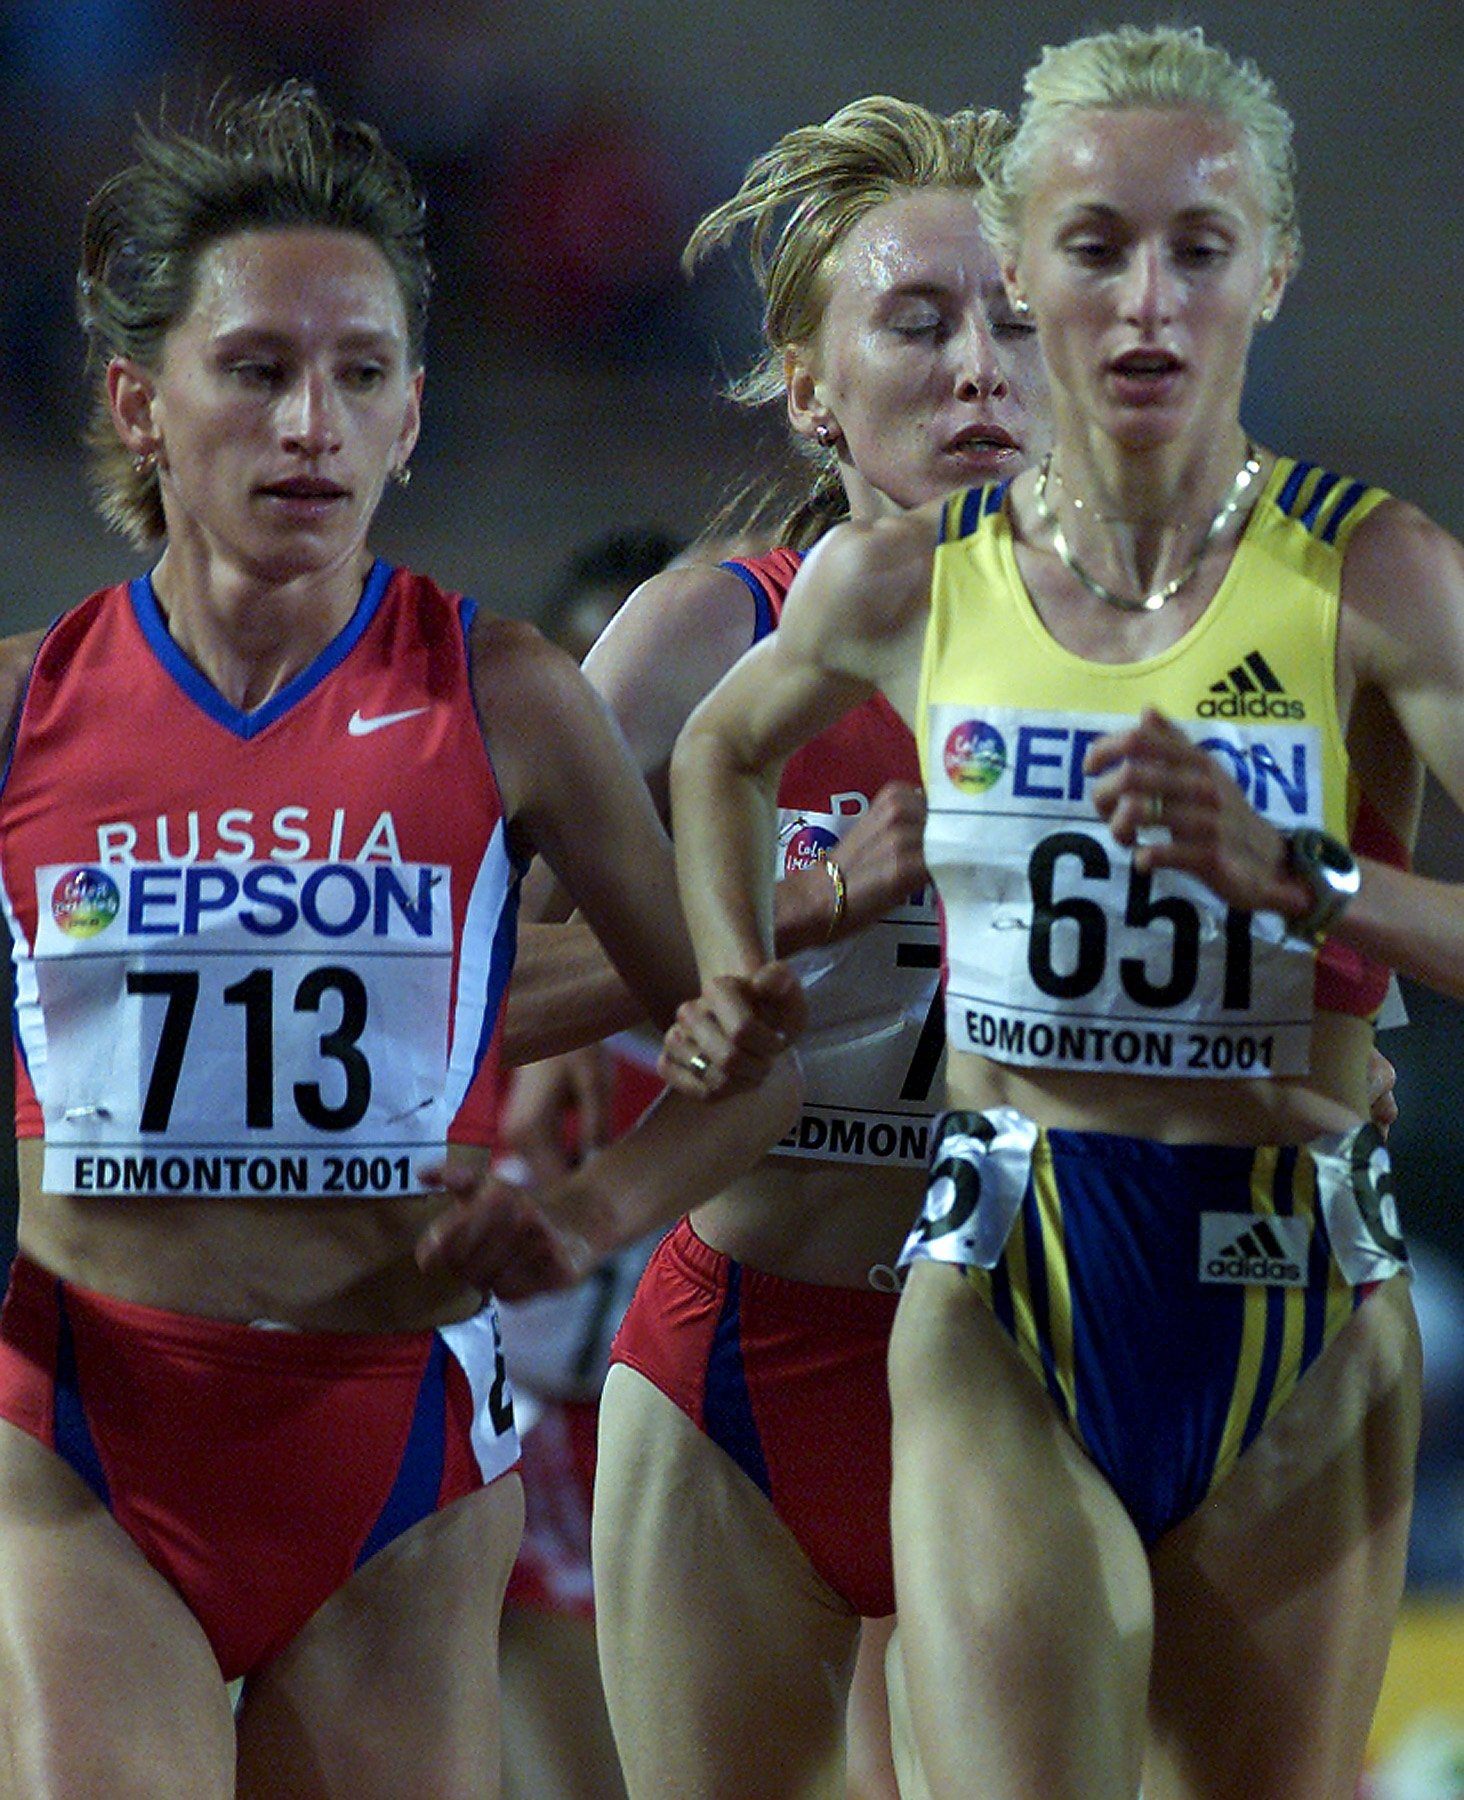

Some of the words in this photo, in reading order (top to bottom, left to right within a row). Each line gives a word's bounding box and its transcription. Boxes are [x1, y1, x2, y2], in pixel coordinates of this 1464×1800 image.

[1196, 692, 1305, 719] adidas
[1012, 726, 1308, 815] EPN
[98, 808, 402, 864] RUSSIA
[127, 866, 433, 936] EPSON
[126, 967, 372, 1133] 713
[965, 1011, 1172, 1066] EDMONTON
[1187, 1035, 1275, 1069] 2001
[74, 1156, 308, 1190] EDMONTON
[322, 1156, 411, 1190] 2001
[1207, 1256, 1300, 1281] adidas
